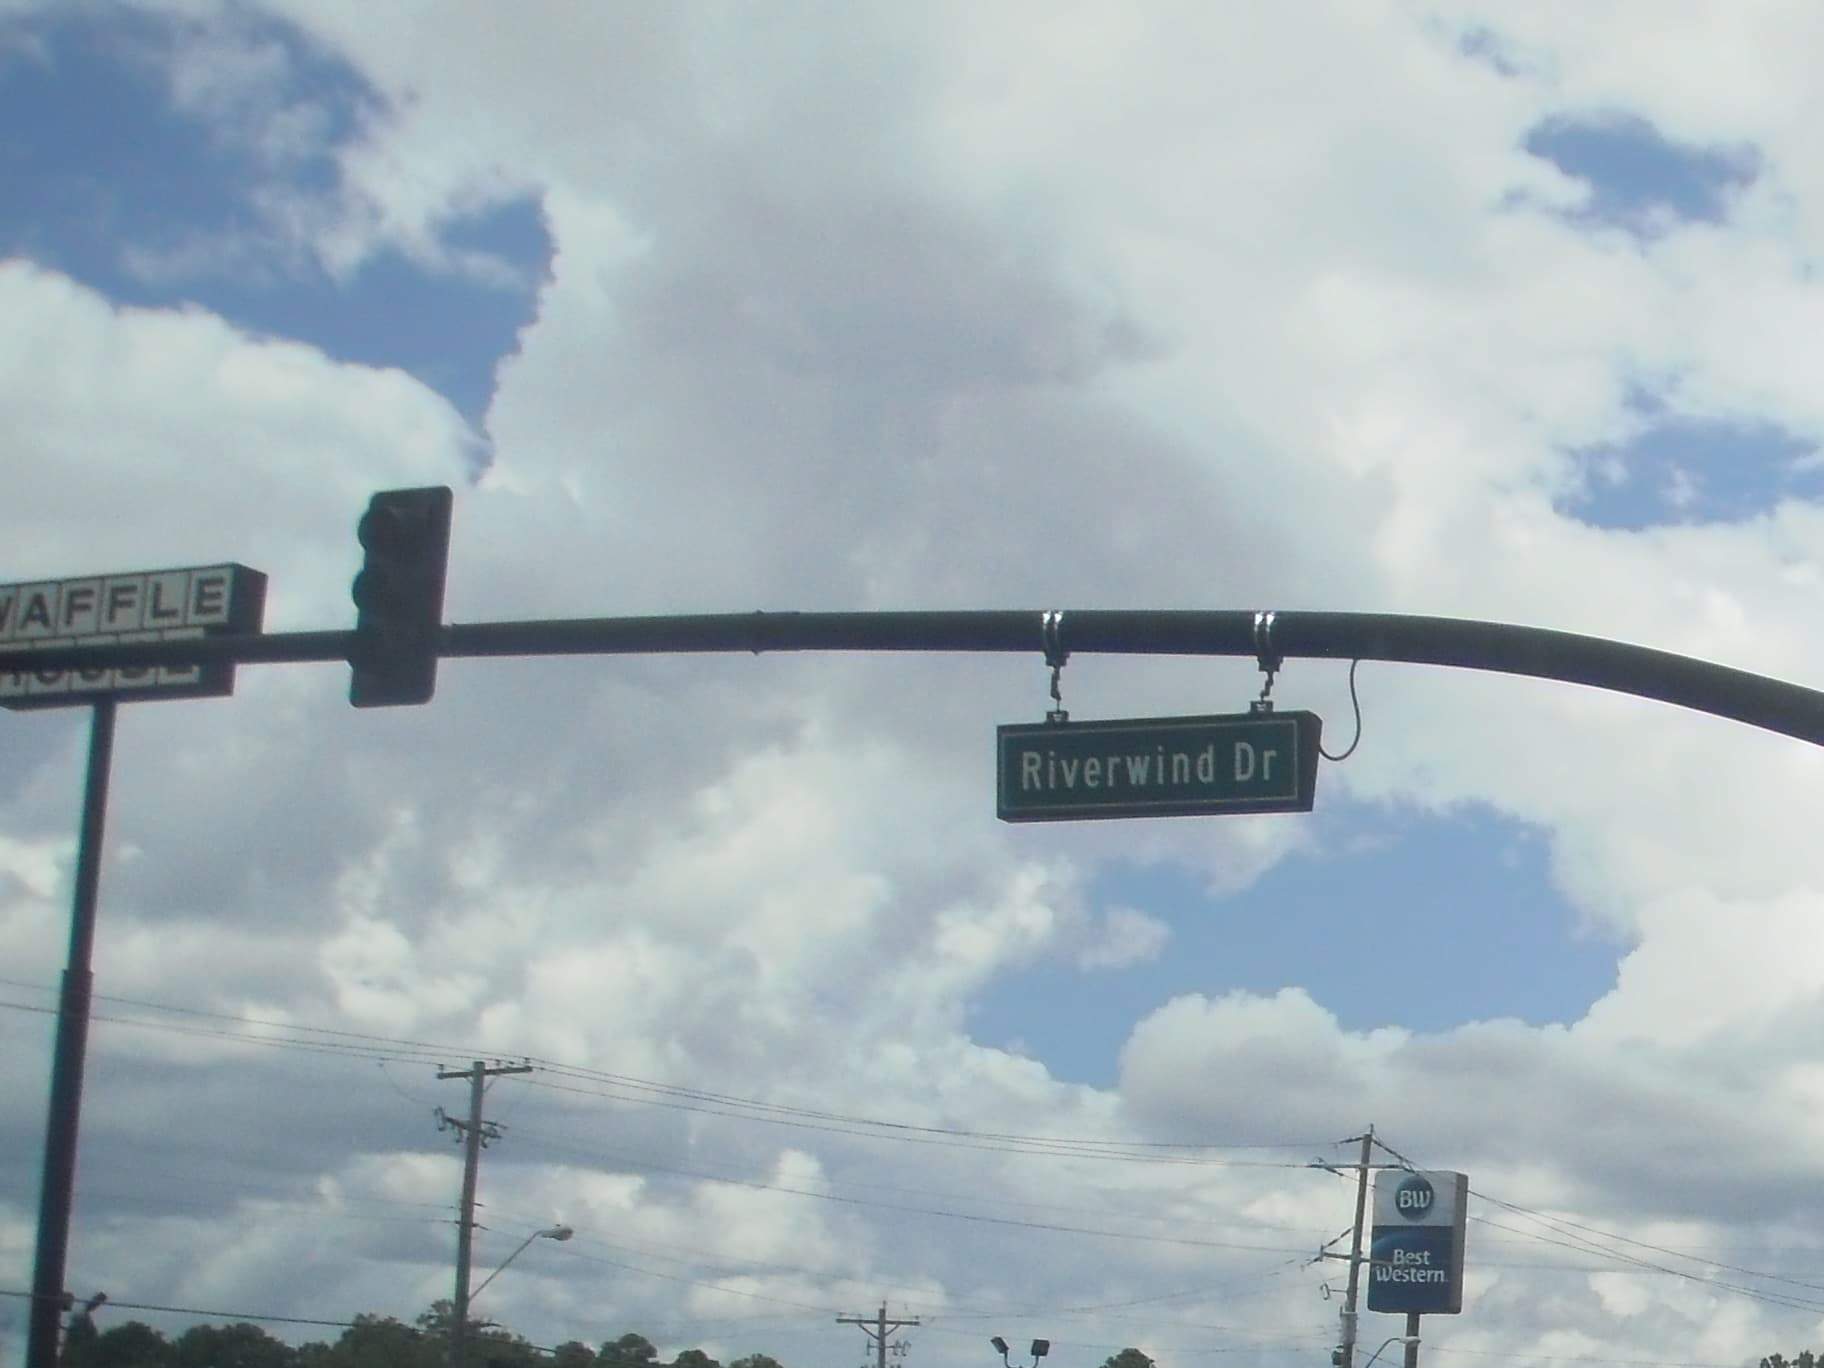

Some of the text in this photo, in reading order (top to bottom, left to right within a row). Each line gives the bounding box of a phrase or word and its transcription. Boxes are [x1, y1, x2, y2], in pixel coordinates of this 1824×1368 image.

[1021, 741, 1278, 791] Riverwind Dr
[1399, 1189, 1431, 1208] BW
[1393, 1248, 1431, 1265] Best
[1375, 1265, 1446, 1283] Western
